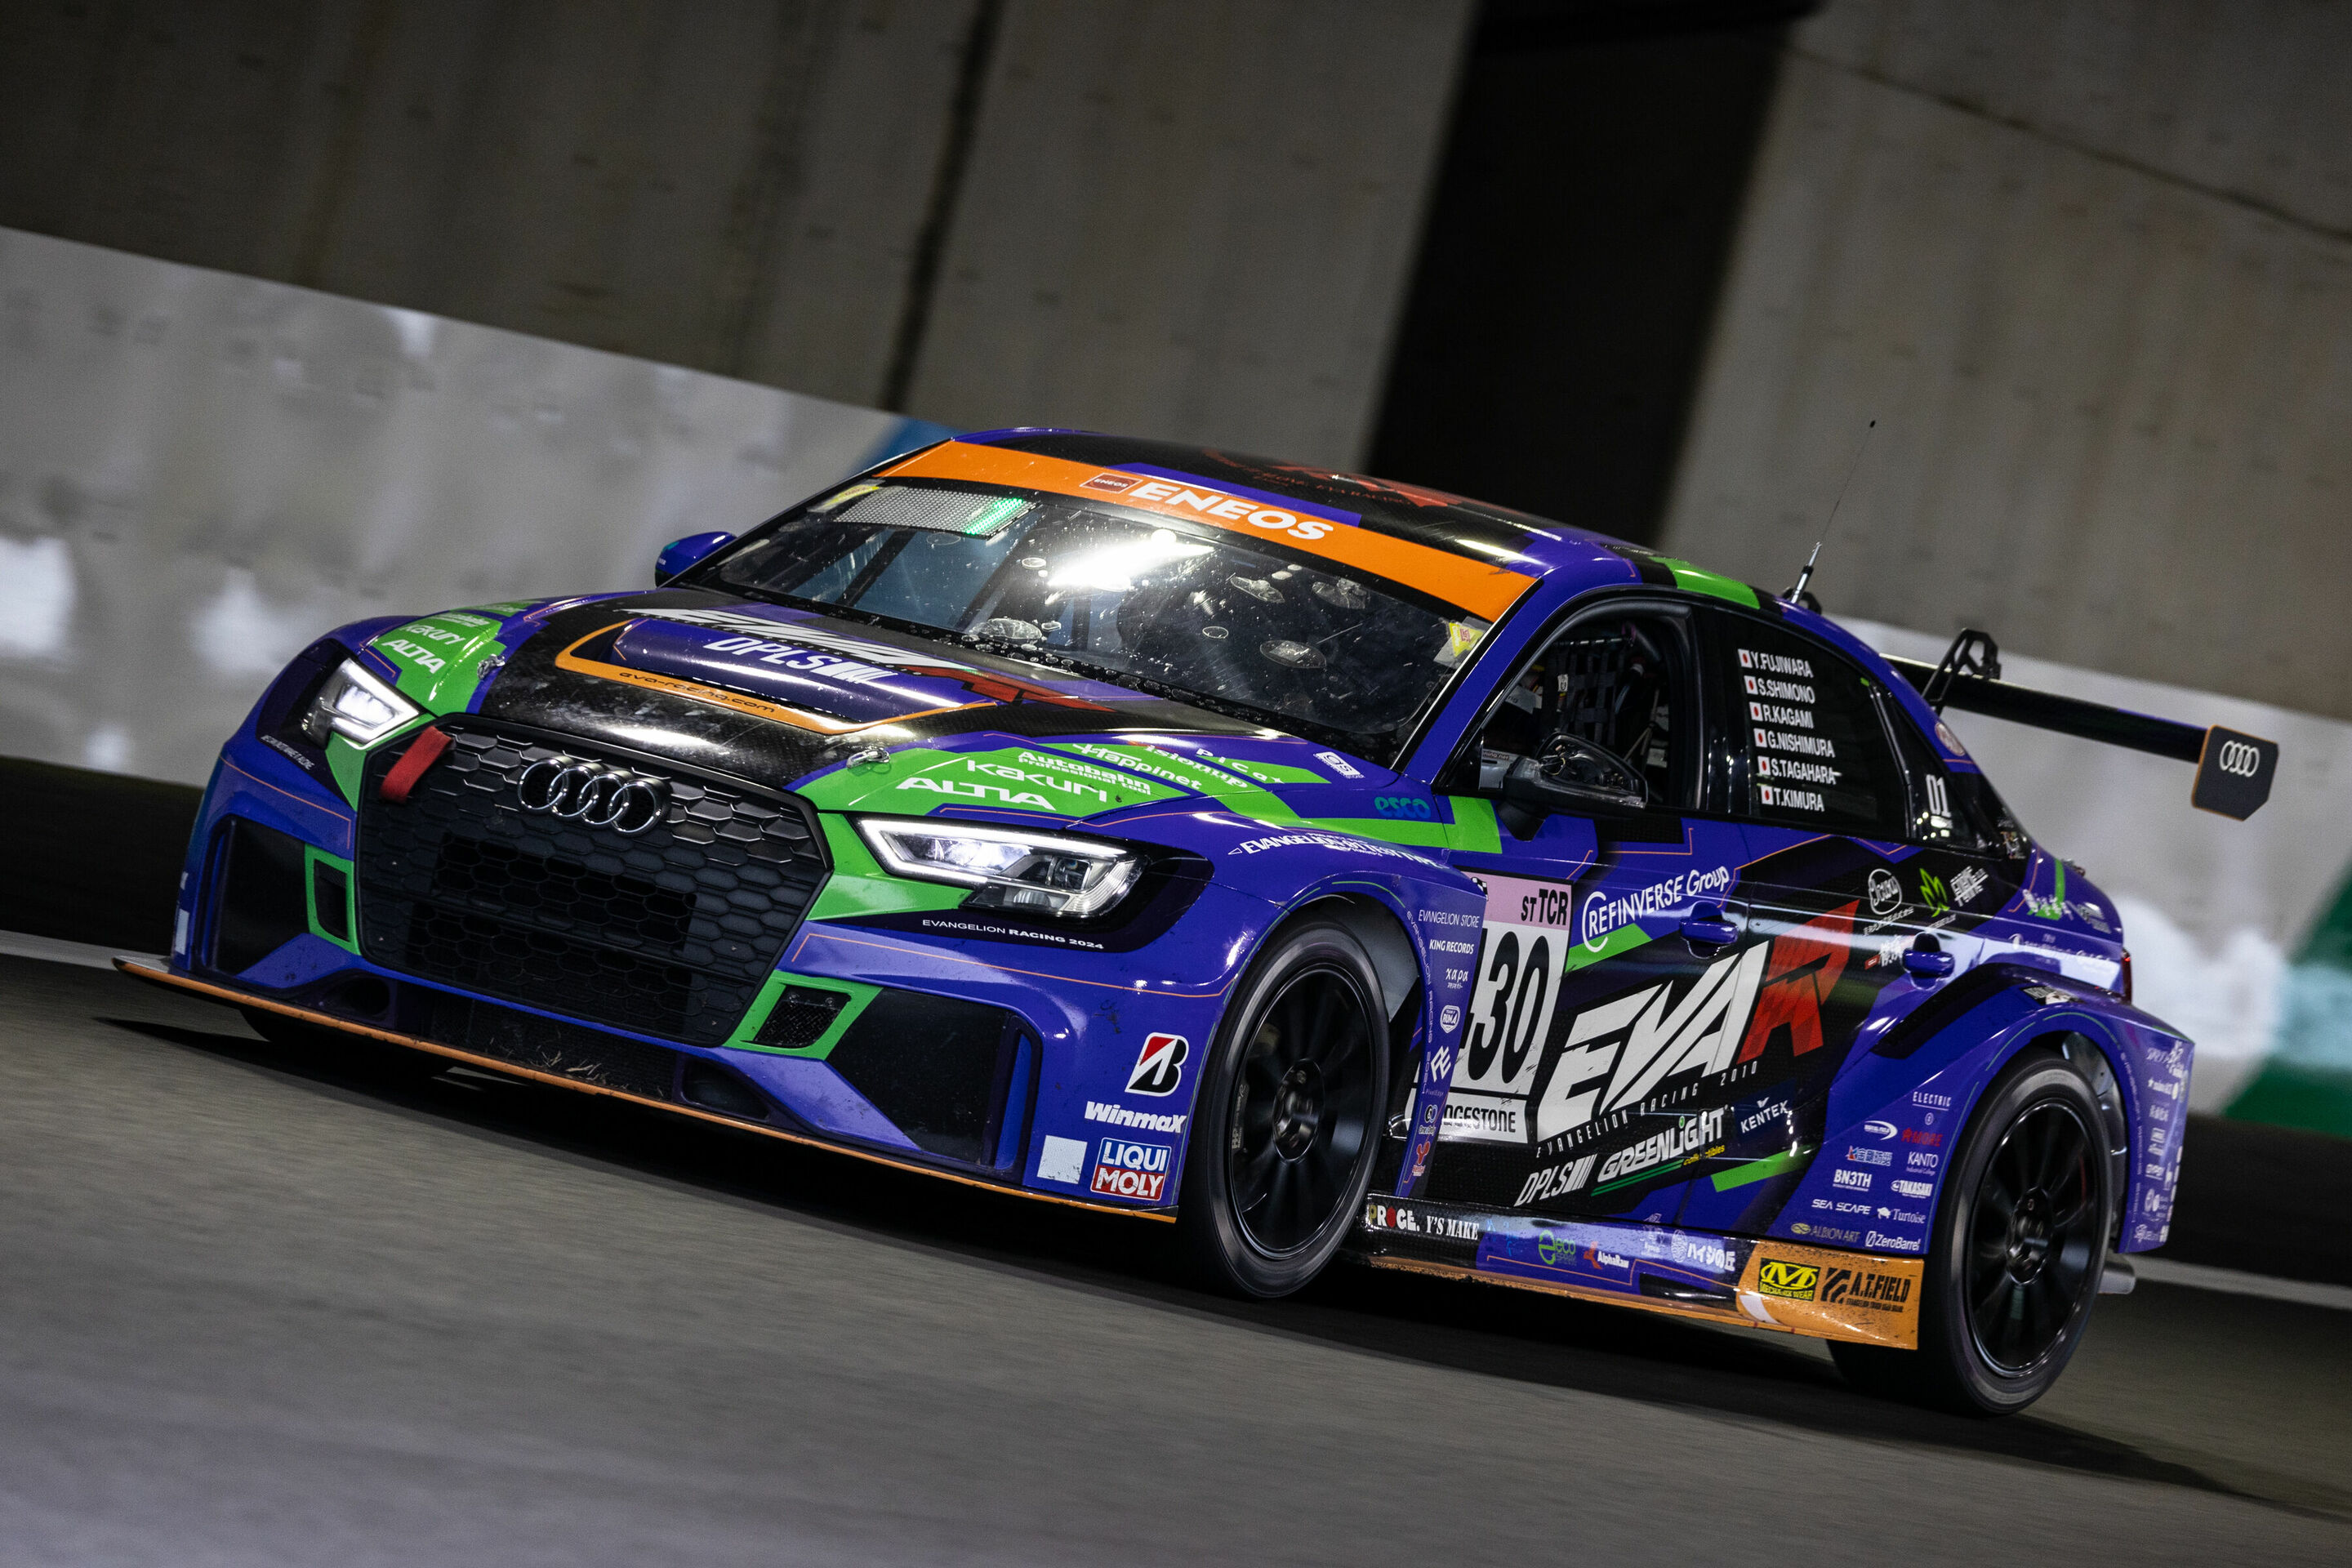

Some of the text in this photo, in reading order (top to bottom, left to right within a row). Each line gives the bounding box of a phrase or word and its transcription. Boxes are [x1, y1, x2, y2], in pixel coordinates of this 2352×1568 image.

[1094, 479, 1128, 488] ENEOS
[1129, 482, 1334, 541] ENEOS
[1751, 651, 1814, 679] Y.FUJIWARA
[1757, 678, 1815, 704] S.SHIMONO
[1762, 704, 1815, 728] R.KAGAMI
[1767, 730, 1836, 758] G.NISHIMURA
[1018, 751, 1151, 790] Autobahn
[1771, 759, 1836, 785] S.TAGAHARA
[1122, 782, 1151, 795] tool
[1773, 788, 1825, 812] T.KIMURA
[1926, 774, 1952, 817] 01
[1588, 866, 1730, 937] REFINVERSE Group
[1418, 910, 1480, 928] EVANGELION STORE
[923, 919, 1104, 949] EVANGELION RACING 2024
[1429, 939, 1474, 954] KING RECORDS
[1641, 1082, 1699, 1116] RACING
[1720, 1061, 1757, 1087] 2010
[1913, 1091, 1952, 1107] ELECTRIC
[1740, 1100, 1788, 1134] KENTEX
[1102, 1141, 1167, 1172] LIQUI
[1907, 1151, 1939, 1168] KANTO
[1095, 1167, 1165, 1198] MOLY
[1833, 1169, 1873, 1187] BN3TH
[1811, 1199, 1872, 1214] SEA SCAPE
[1893, 1209, 1927, 1224] Turtoise
[1446, 1219, 1480, 1241] MAKE
[1810, 1225, 1861, 1242] ALBION ART
[1874, 1234, 1921, 1251] ZeroBarrel
[1849, 1272, 1911, 1303] A.T.FIELD
